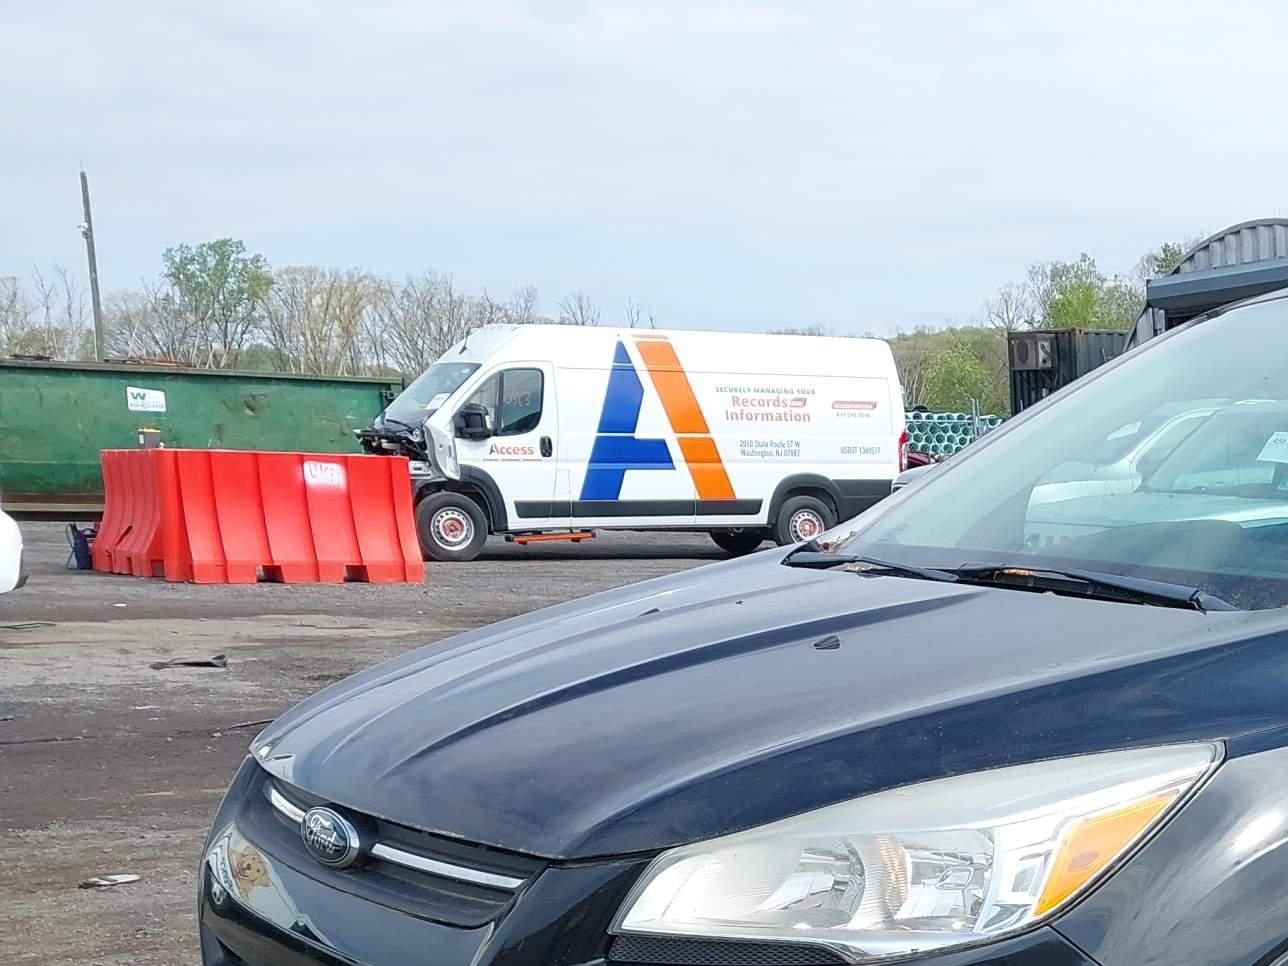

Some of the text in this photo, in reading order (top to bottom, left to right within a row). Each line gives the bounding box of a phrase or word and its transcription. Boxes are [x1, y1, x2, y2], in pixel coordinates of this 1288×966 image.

[715, 386, 751, 394] SECURELY
[753, 387, 794, 395] MANAGING
[731, 395, 788, 408] Records
[725, 409, 811, 422] Information
[489, 442, 535, 455] Access
[307, 814, 347, 854] Ford
